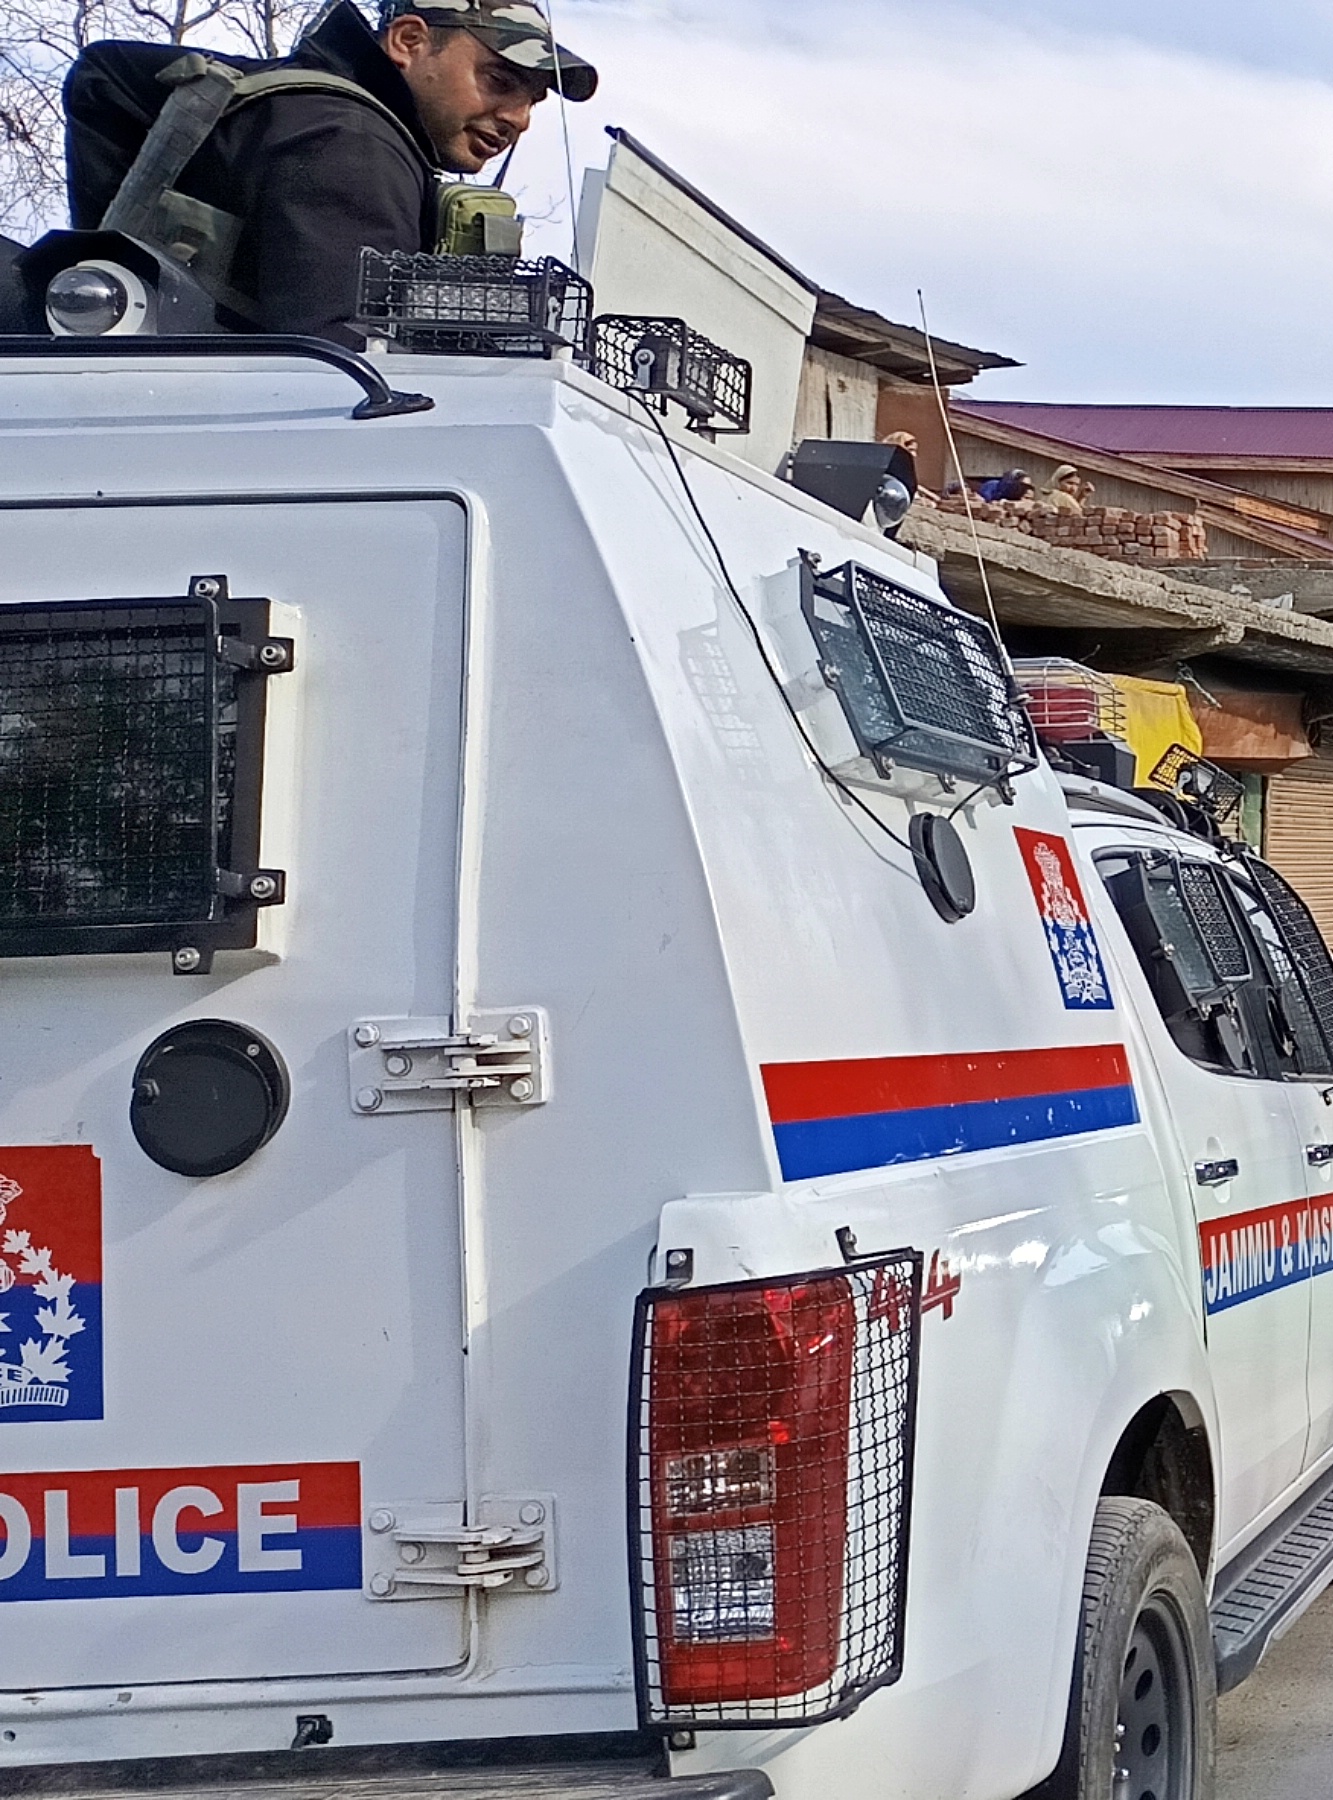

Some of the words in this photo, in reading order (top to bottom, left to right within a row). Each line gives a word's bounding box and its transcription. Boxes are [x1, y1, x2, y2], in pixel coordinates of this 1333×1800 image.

[868, 1249, 961, 1334] 44
[1206, 1219, 1276, 1305] JAMMU
[1281, 1214, 1294, 1276] &
